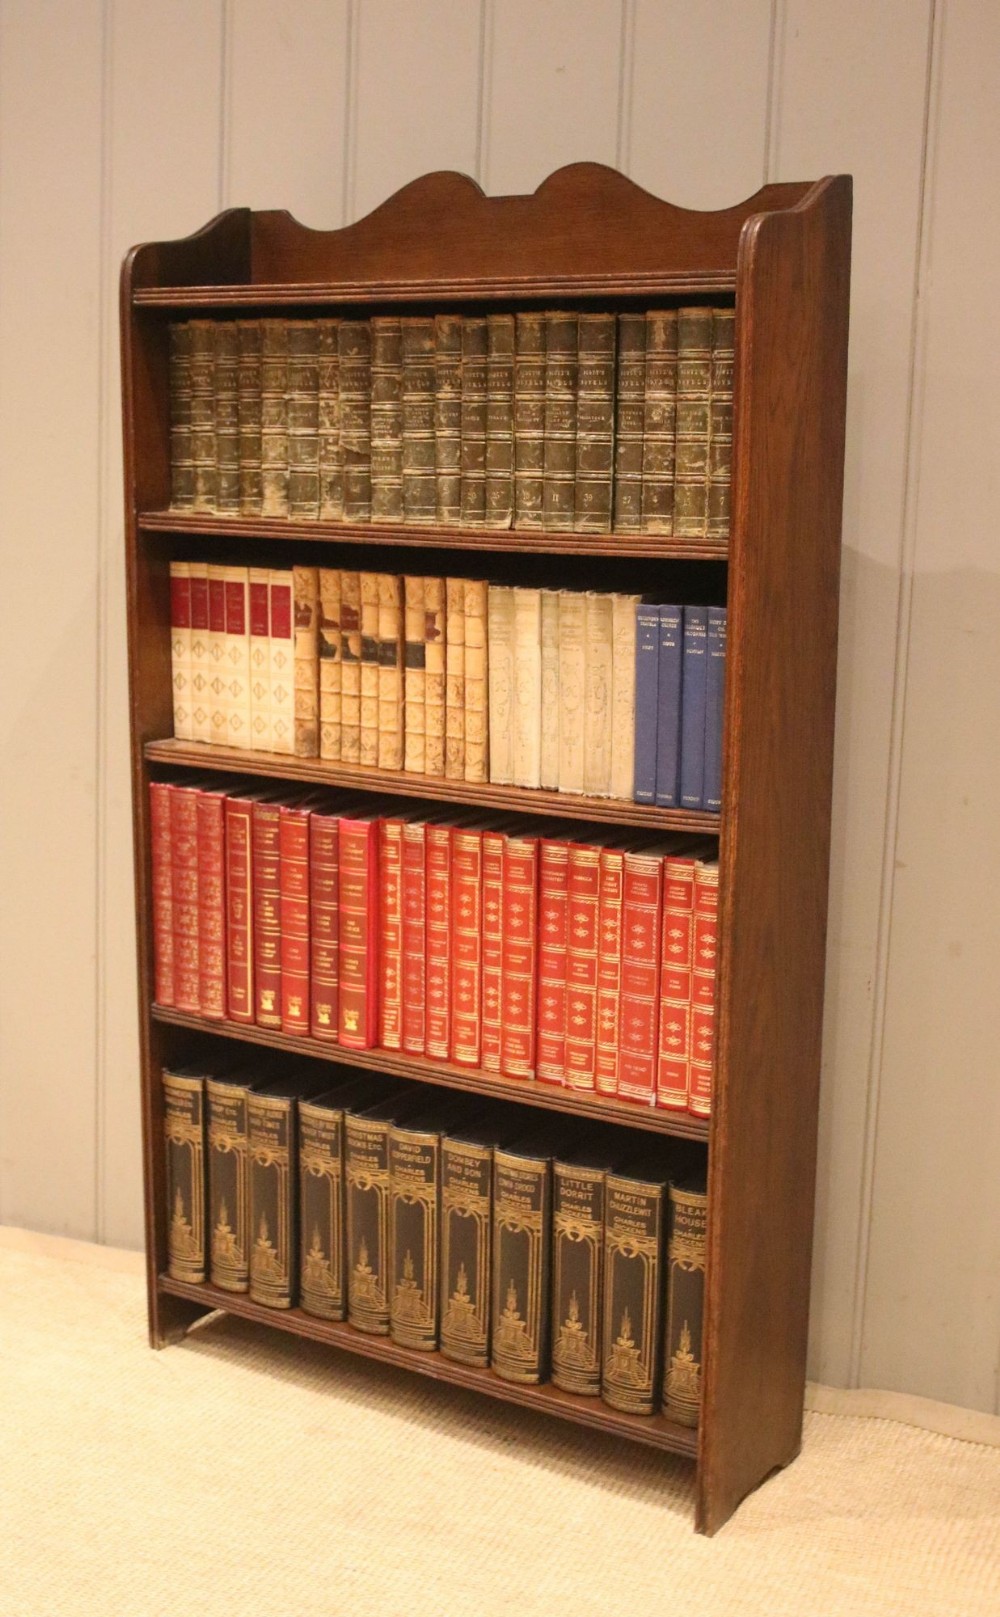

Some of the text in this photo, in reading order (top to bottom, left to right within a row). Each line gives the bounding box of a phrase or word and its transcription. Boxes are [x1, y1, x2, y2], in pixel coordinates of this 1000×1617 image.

[399, 1143, 421, 1154] DAVID
[447, 1153, 481, 1168] DOMBEY
[447, 1163, 482, 1179] AND SON
[560, 1178, 594, 1191] LITTLE
[560, 1187, 594, 1201] DORRIT
[614, 1192, 647, 1206] MARTIN
[560, 1201, 593, 1213] CHARLES
[613, 1216, 647, 1228] CHARLES
[675, 1214, 707, 1228] HOUSE
